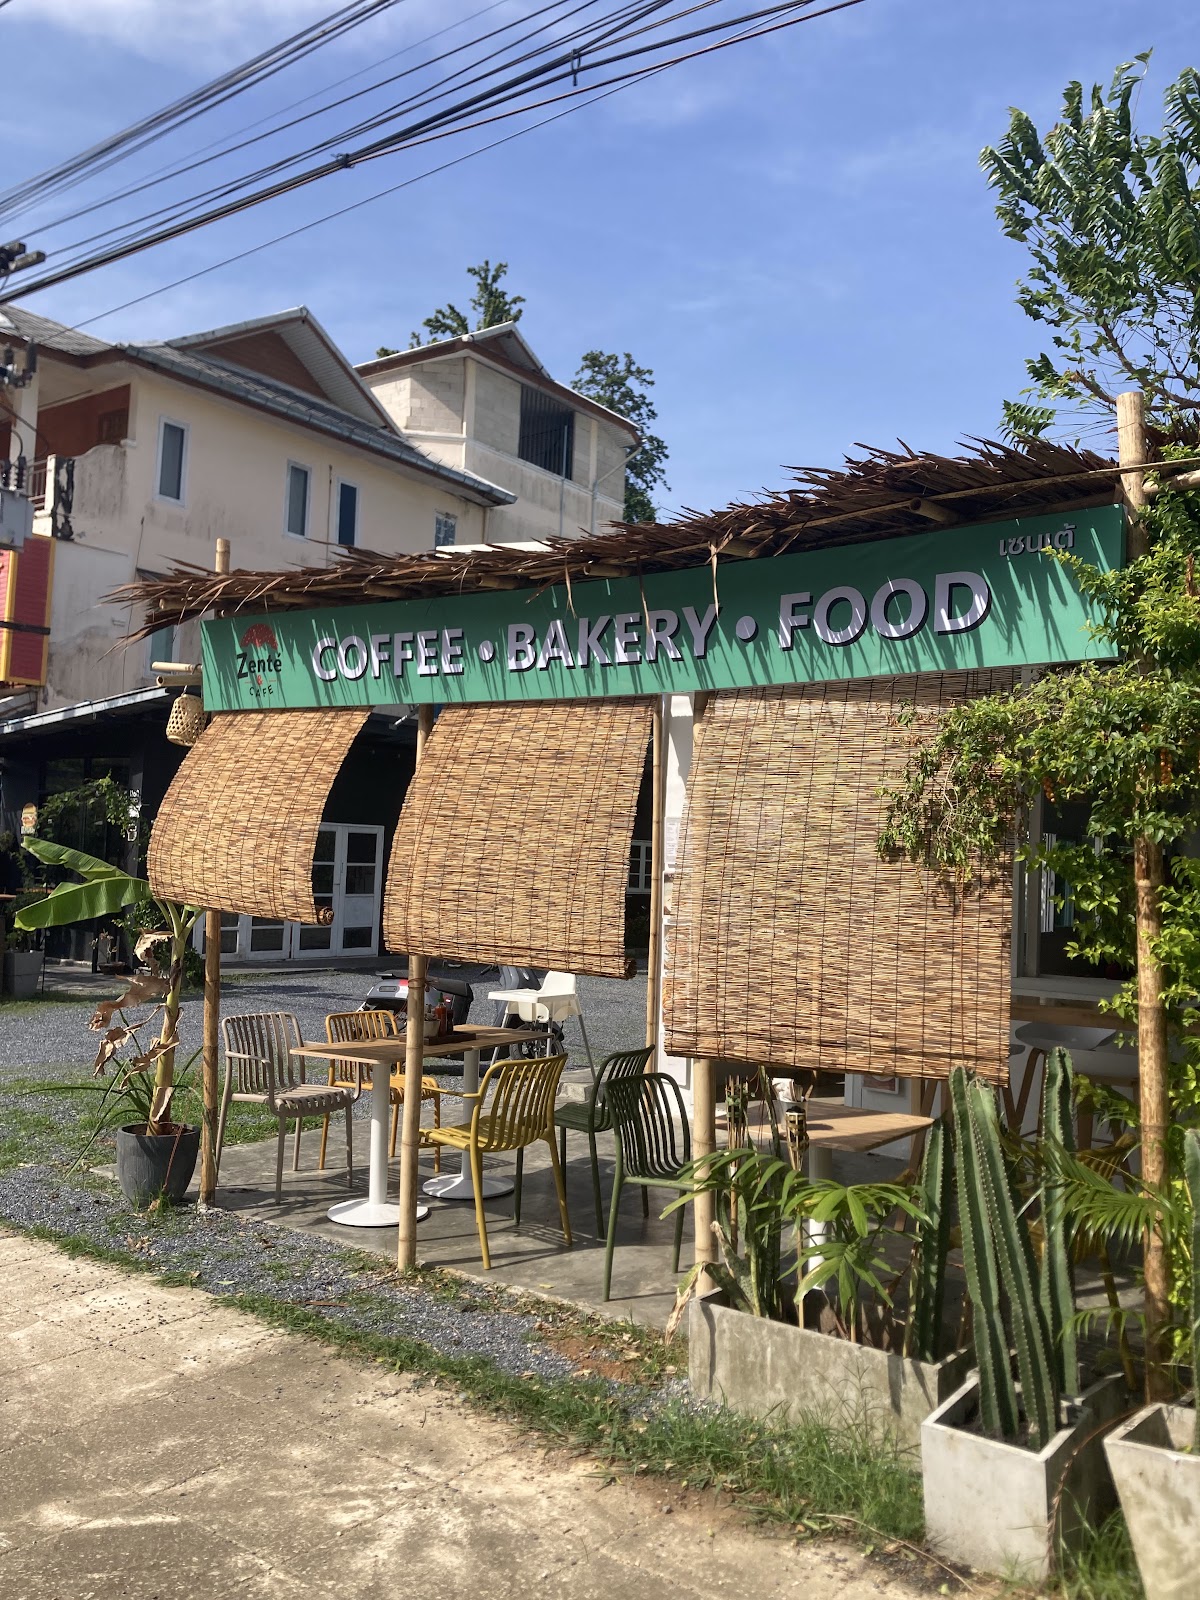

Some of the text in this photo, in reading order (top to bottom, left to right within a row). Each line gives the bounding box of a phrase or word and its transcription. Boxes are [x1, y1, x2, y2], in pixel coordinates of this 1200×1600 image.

[312, 571, 992, 682] COFFEE BAKERY FOOD
[236, 652, 282, 679] Zenté
